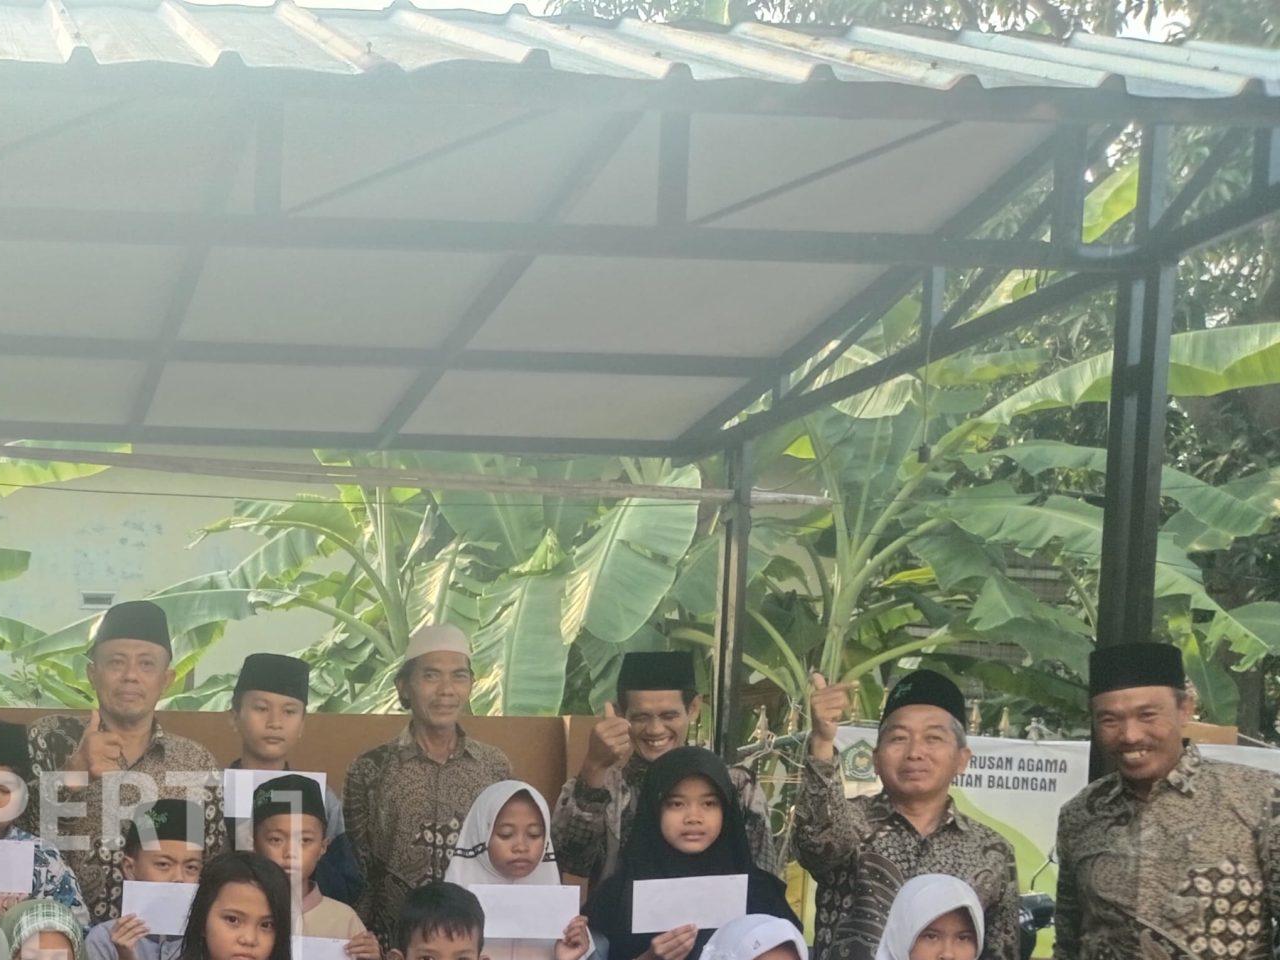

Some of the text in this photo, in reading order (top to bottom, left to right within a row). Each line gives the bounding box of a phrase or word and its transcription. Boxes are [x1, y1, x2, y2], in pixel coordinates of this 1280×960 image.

[969, 755, 1067, 773] RUSAN AGAMA
[951, 773, 1057, 792] ATAN BALONGAN
